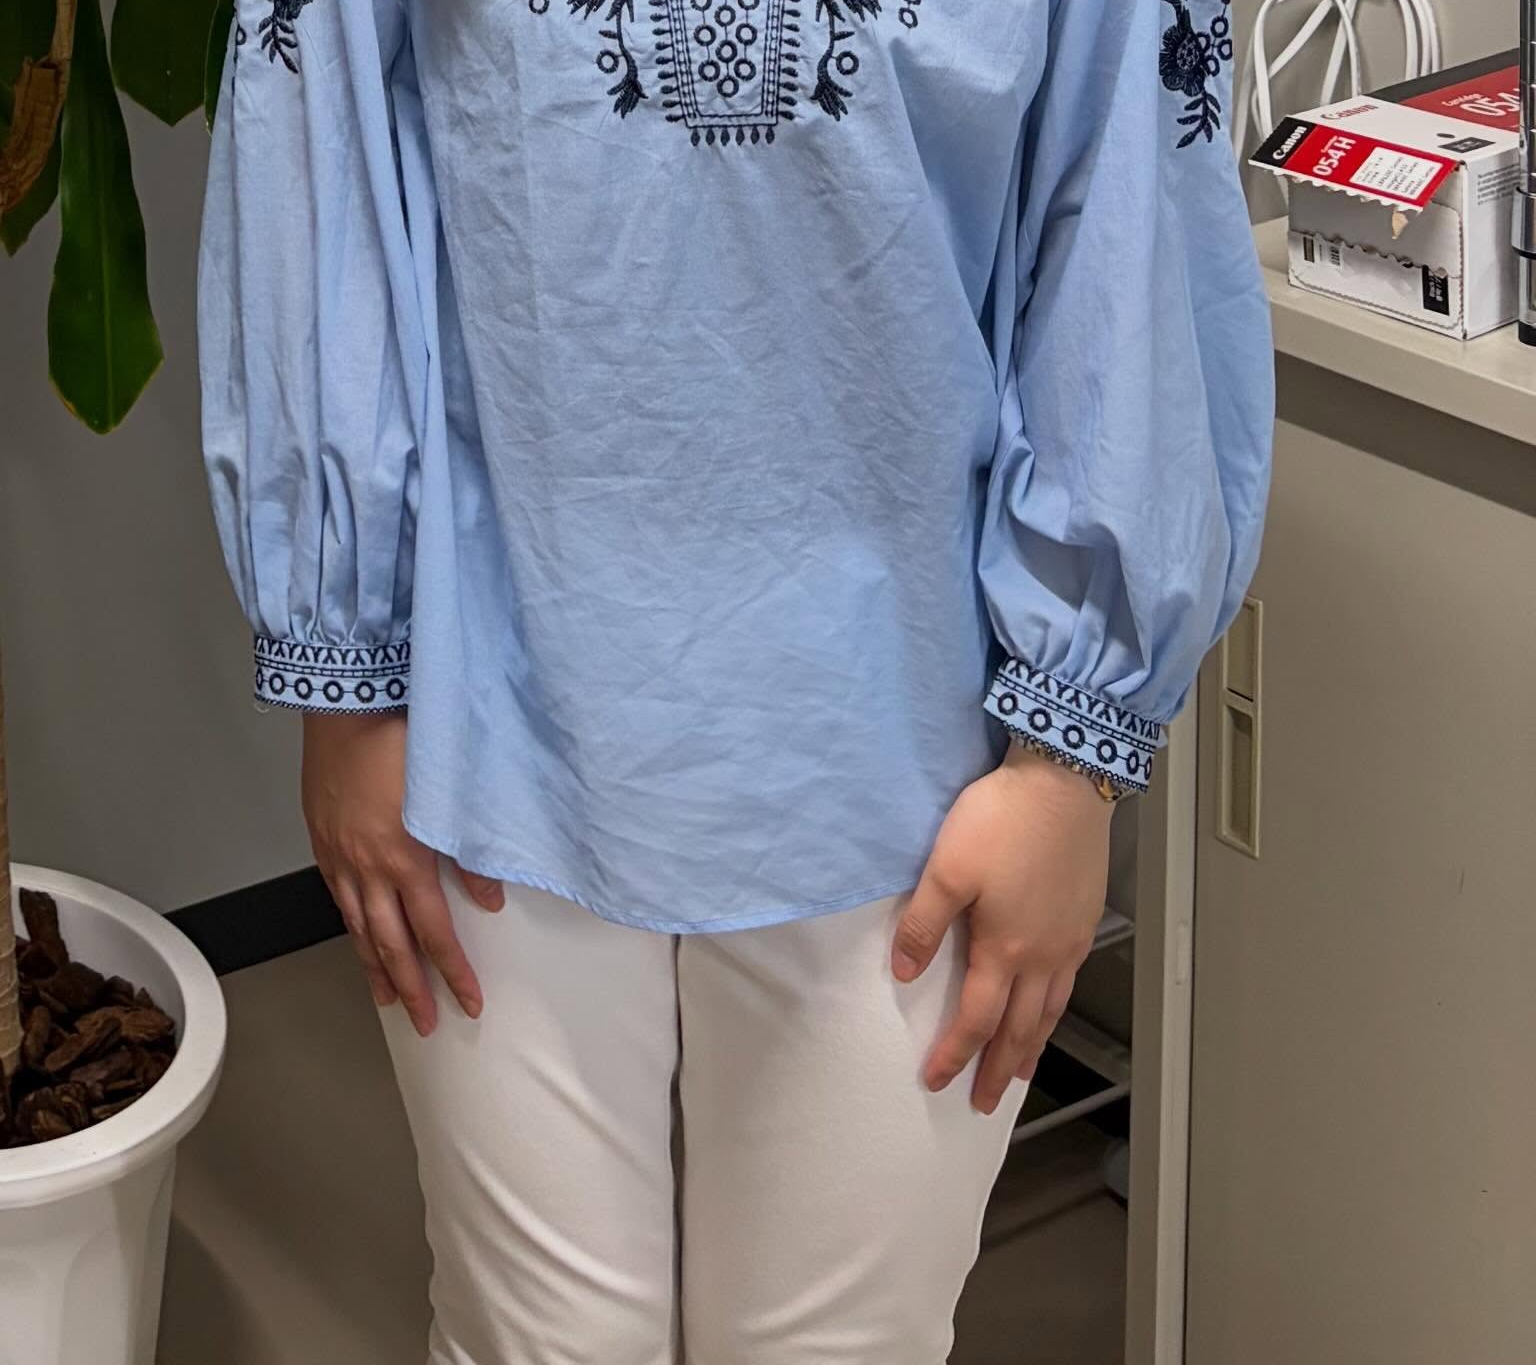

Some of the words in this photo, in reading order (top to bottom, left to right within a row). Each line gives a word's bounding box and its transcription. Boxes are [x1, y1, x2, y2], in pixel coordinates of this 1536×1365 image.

[1320, 103, 1379, 121] Canon
[1272, 126, 1307, 160] Canon
[1312, 149, 1347, 176] 054
[1333, 136, 1357, 150] H
